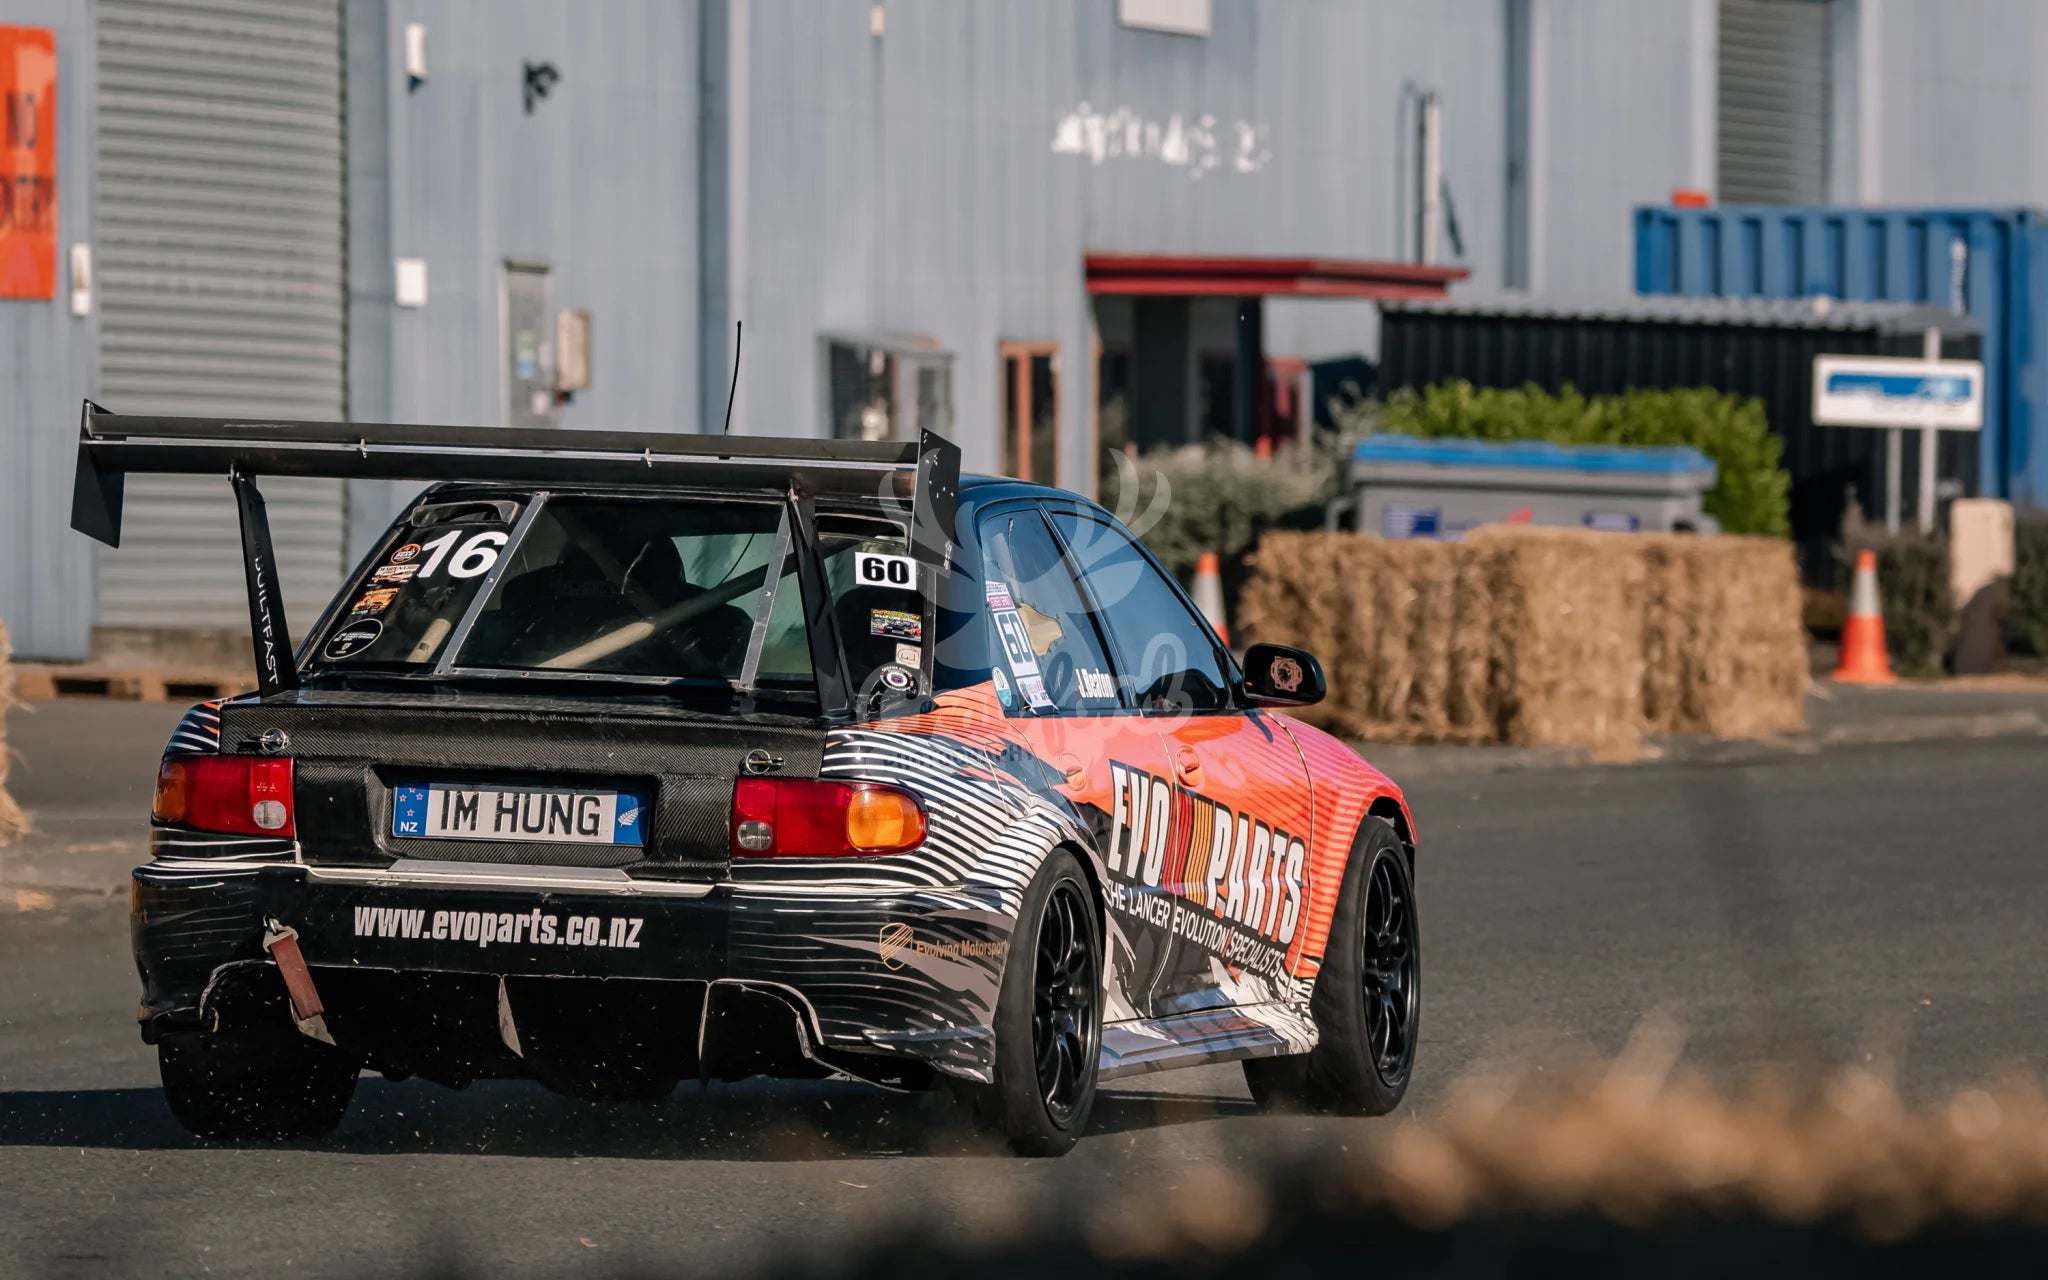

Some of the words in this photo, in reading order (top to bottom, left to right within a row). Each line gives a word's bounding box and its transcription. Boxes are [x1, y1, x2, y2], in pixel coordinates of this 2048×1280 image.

[417, 530, 509, 578] 16
[862, 557, 910, 584] 60
[400, 821, 418, 833] NZ
[493, 791, 601, 837] HUNG
[1108, 762, 1170, 888] EVO
[1207, 804, 1305, 945] PARTS
[354, 906, 644, 948] www.evoparts.co.nz
[1129, 887, 1171, 929] LANCER
[1172, 905, 1228, 961] EVOLUTION
[1226, 931, 1285, 978] SPECIALISTS
[916, 939, 959, 961] Evolving
